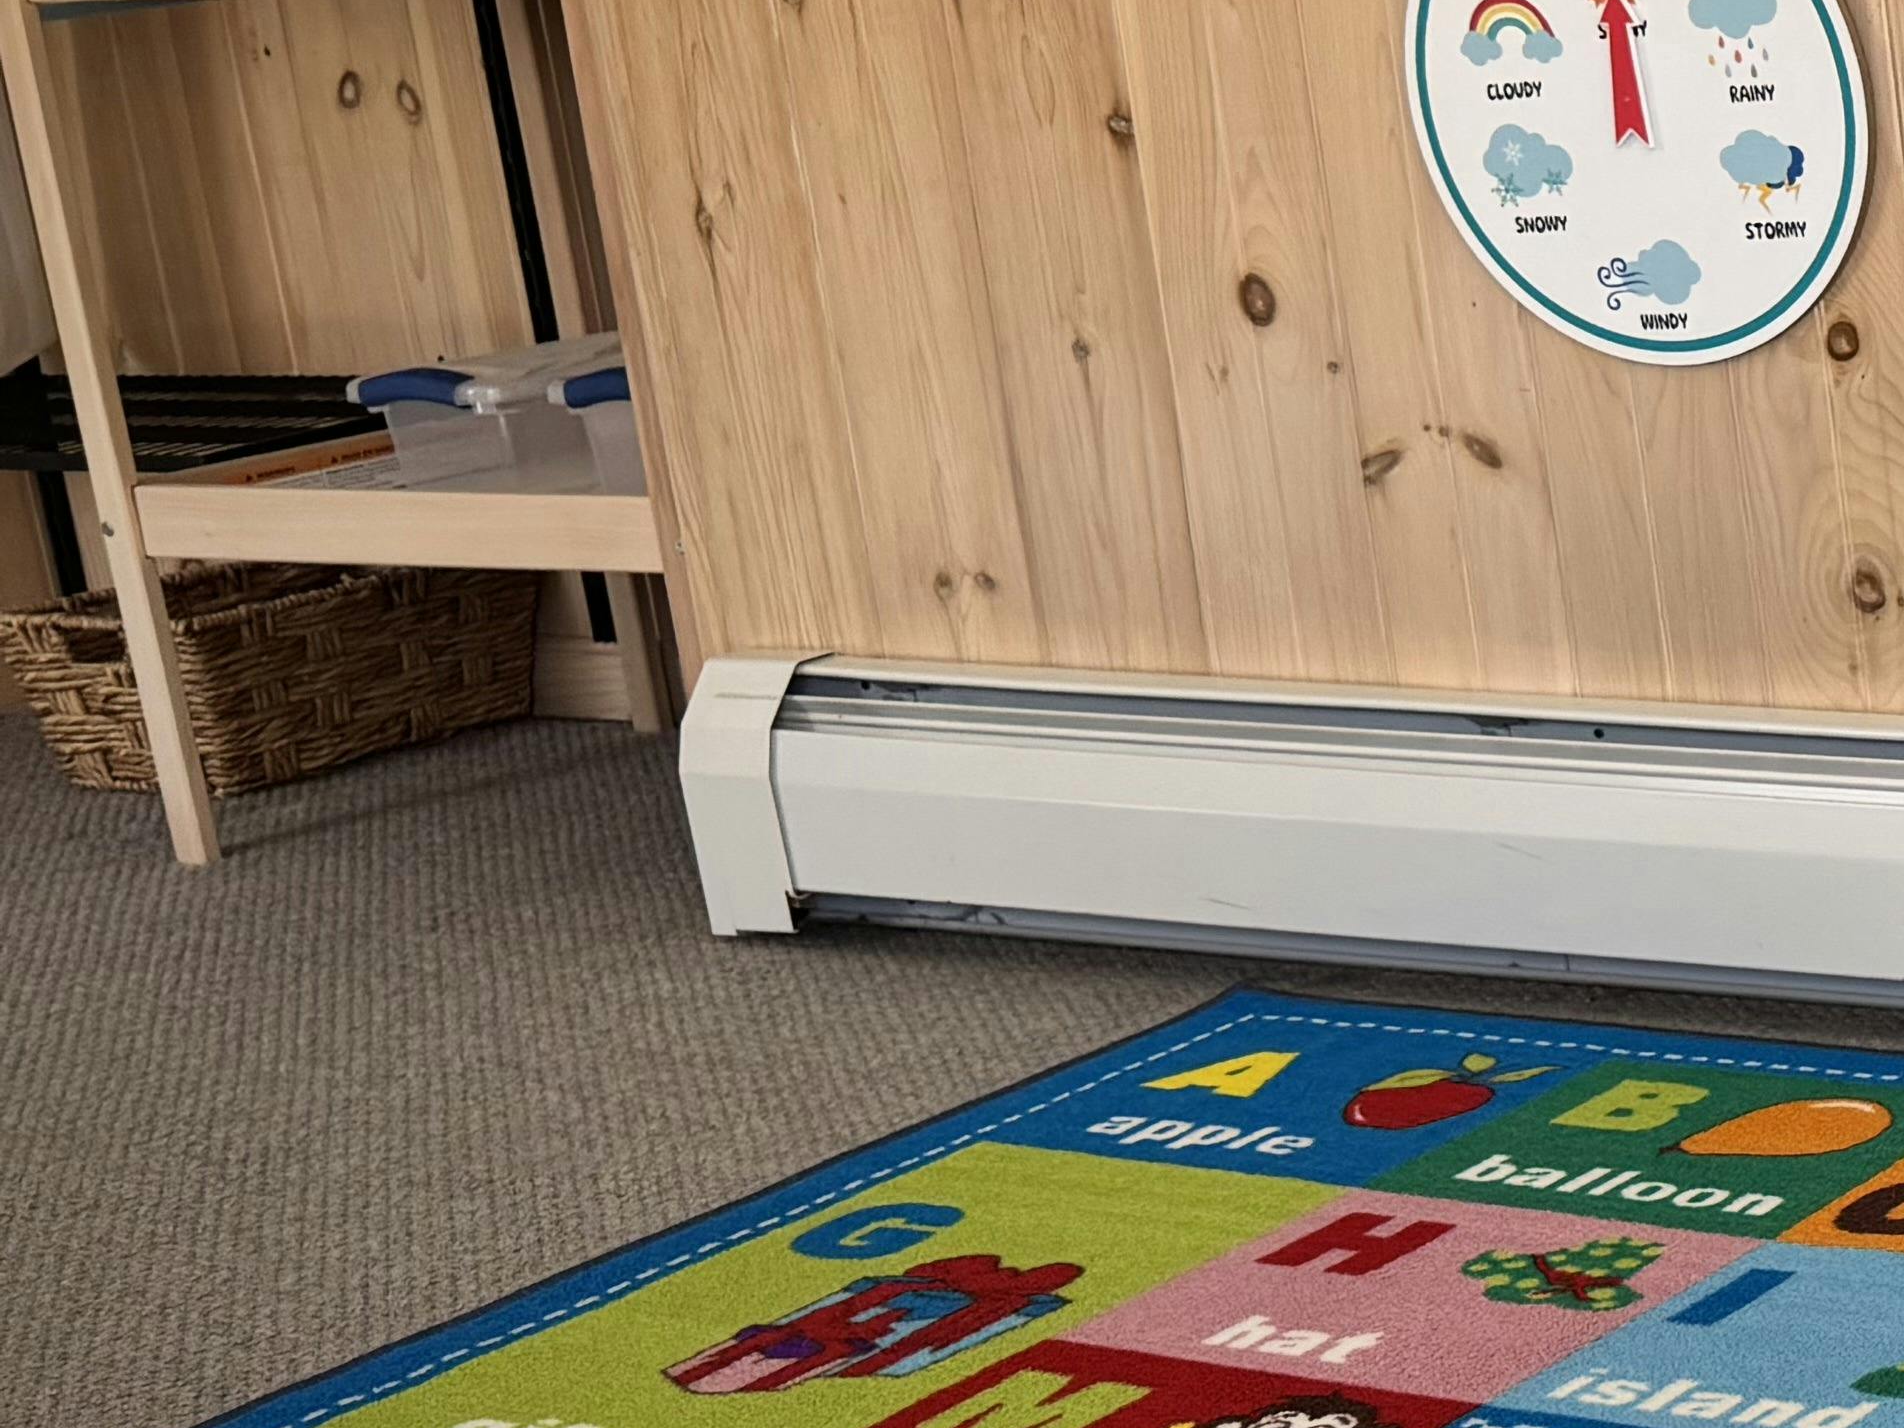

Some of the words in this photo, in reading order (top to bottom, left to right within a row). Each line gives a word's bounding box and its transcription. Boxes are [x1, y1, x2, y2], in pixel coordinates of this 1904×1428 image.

[1487, 81, 1542, 100] CLOUDY
[1730, 85, 1775, 104] RAINY
[1515, 216, 1567, 234] SNOWY
[1745, 221, 1807, 241] STORMY
[1640, 313, 1688, 331] WINDY
[1139, 1052, 1300, 1098] A
[1549, 1078, 1709, 1131] B
[1087, 1108, 1315, 1159] apple
[1454, 1153, 1786, 1217] balloon
[790, 1202, 964, 1260] G
[1254, 1212, 1457, 1277] H
[1667, 1269, 1797, 1325] I
[1201, 1315, 1388, 1364] hat
